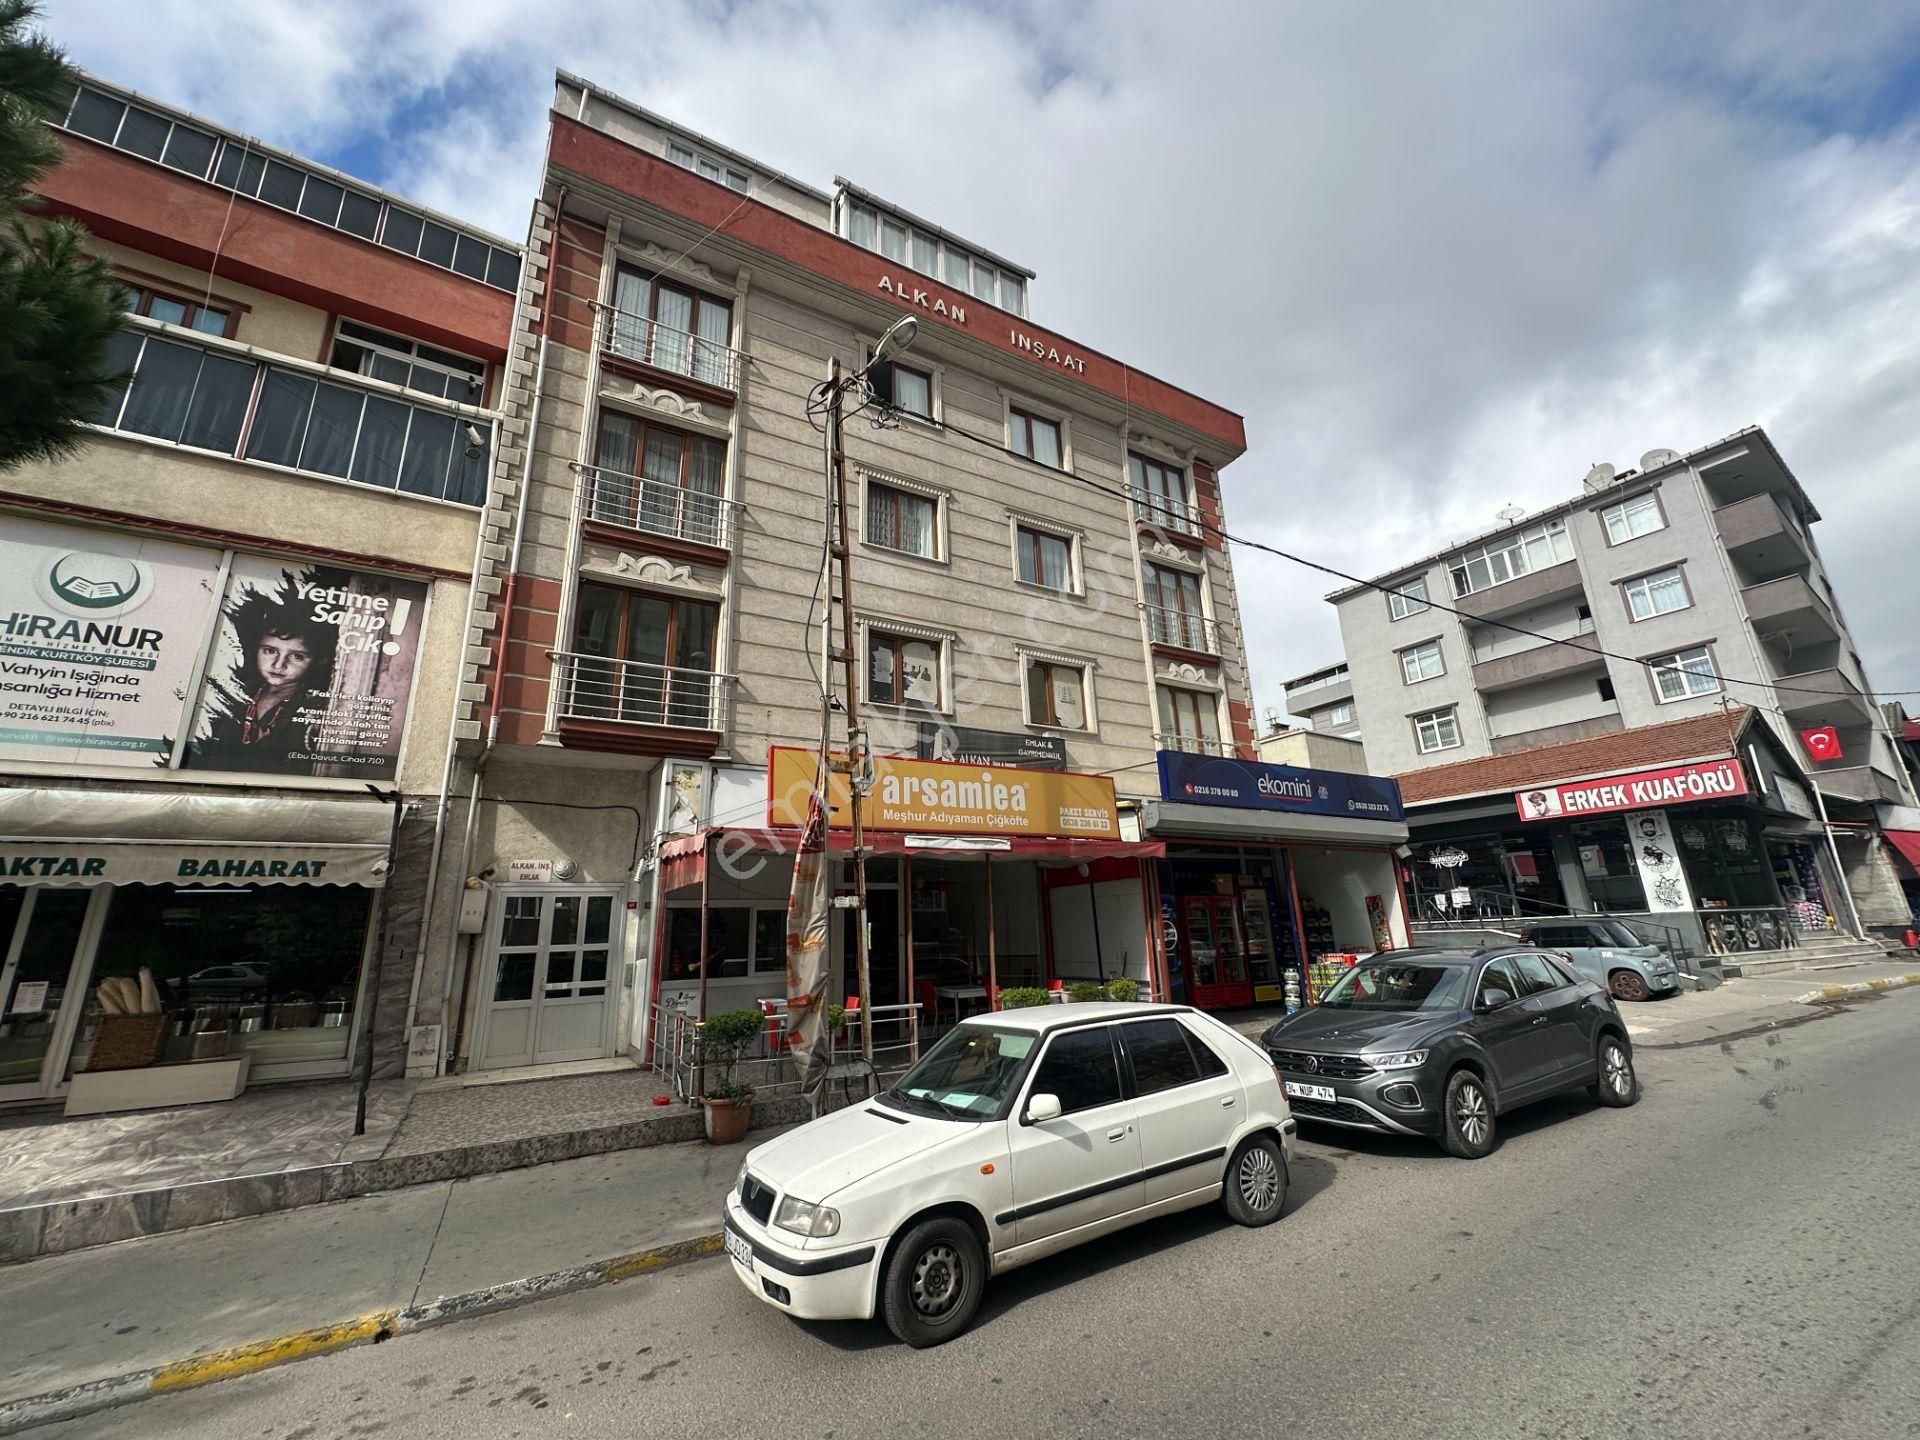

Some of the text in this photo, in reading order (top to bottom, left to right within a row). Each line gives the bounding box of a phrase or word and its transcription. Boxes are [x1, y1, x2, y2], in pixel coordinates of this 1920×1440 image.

[878, 275, 966, 323] ALKAN
[293, 579, 389, 611] Yetime
[310, 603, 386, 633] Sahip
[41, 649, 102, 663] KURTKÖY
[104, 656, 150, 669] ŞUBESİ
[1, 661, 140, 686] Vahyin Işığında
[75, 686, 141, 703] Hizmet
[9, 702, 54, 713] DETAYLI
[19, 712, 39, 721] 216
[41, 714, 60, 722] 621
[62, 716, 75, 724] 74
[76, 717, 90, 725] 45
[92, 718, 115, 727] (pbx)
[292, 715, 343, 725] sayesinde
[322, 728, 389, 740] yardım görüp
[1025, 739, 1053, 749] EMLAK &
[287, 751, 309, 760] (Ebu
[1257, 773, 1312, 798] ekomini
[1562, 764, 1737, 812] ERKEK KUAFÖRÜ
[883, 808, 1029, 828] Meşhur Adıyaman Çiğköfte
[1060, 806, 1109, 818] PAKET SERVİS
[177, 858, 327, 877] BAHARAT
[520, 873, 539, 881] EMLAK
[1286, 1083, 1333, 1100] 34 NUP 474
